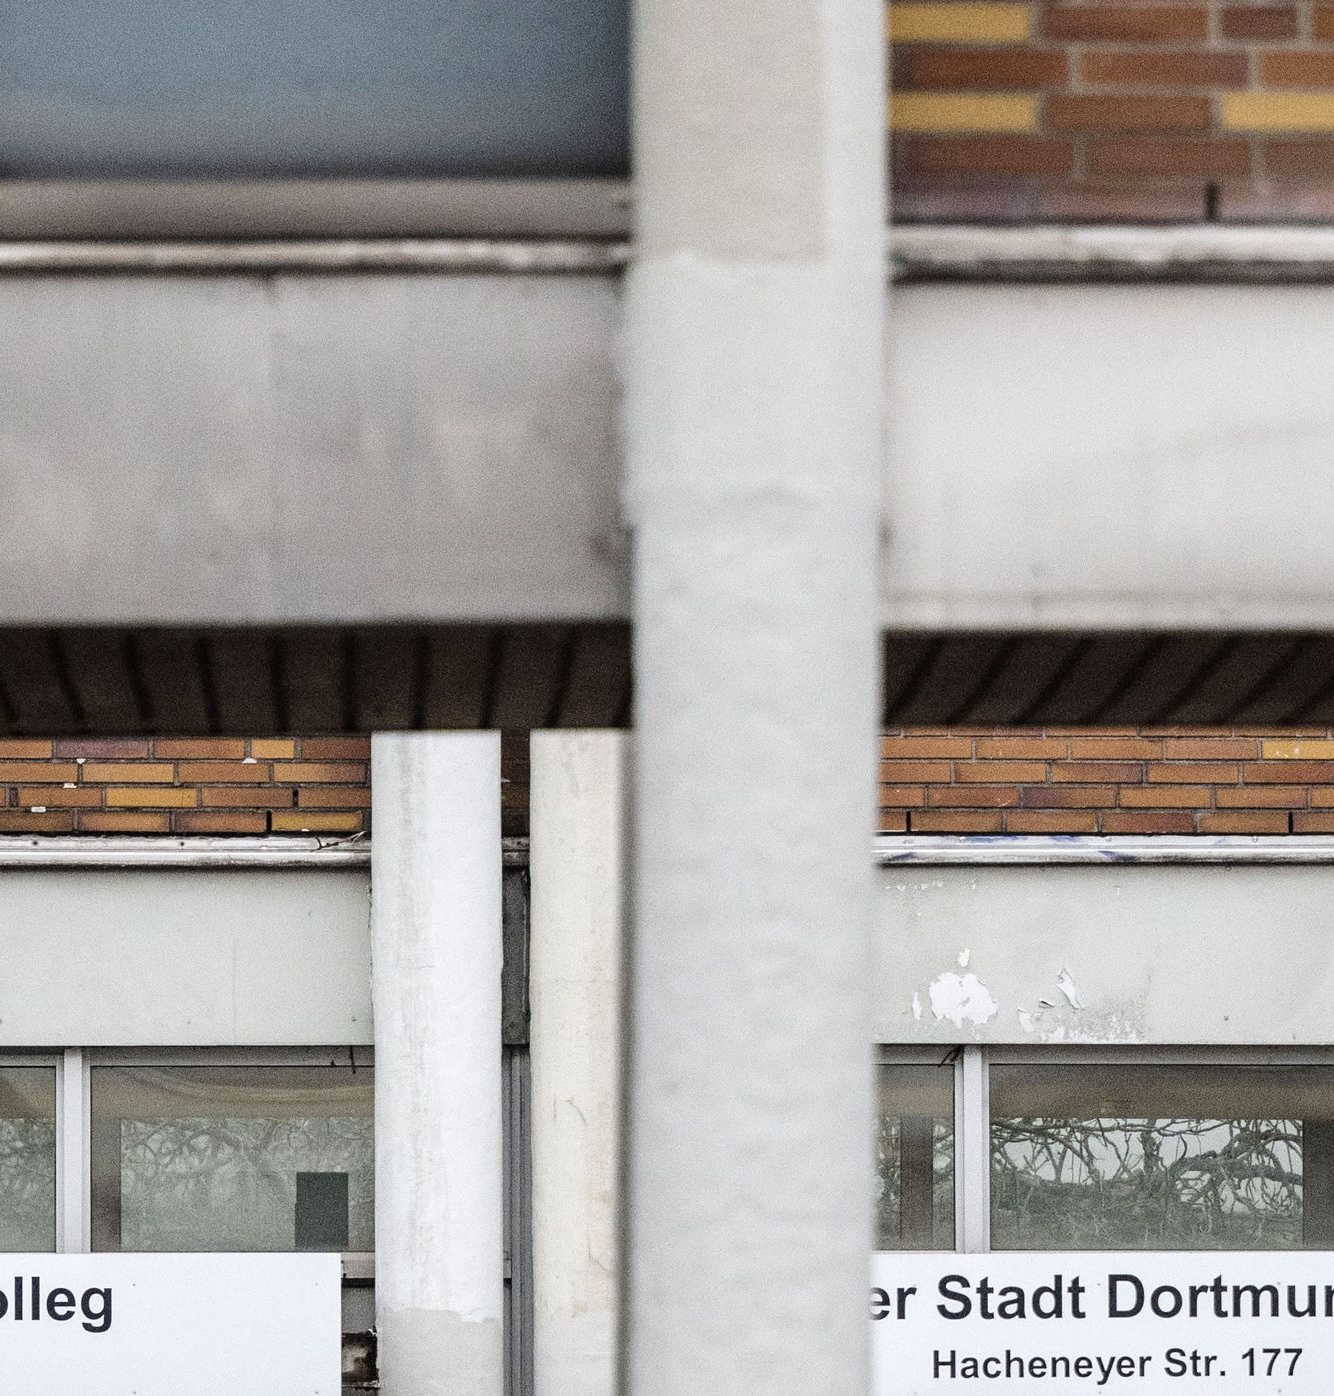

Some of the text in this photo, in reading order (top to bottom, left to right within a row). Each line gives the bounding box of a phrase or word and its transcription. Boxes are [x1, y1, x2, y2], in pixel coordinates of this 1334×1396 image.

[869, 1287, 918, 1320] er
[937, 1274, 1086, 1320] Stadt
[933, 1348, 1303, 1386] Hacheneyer Str. 177
